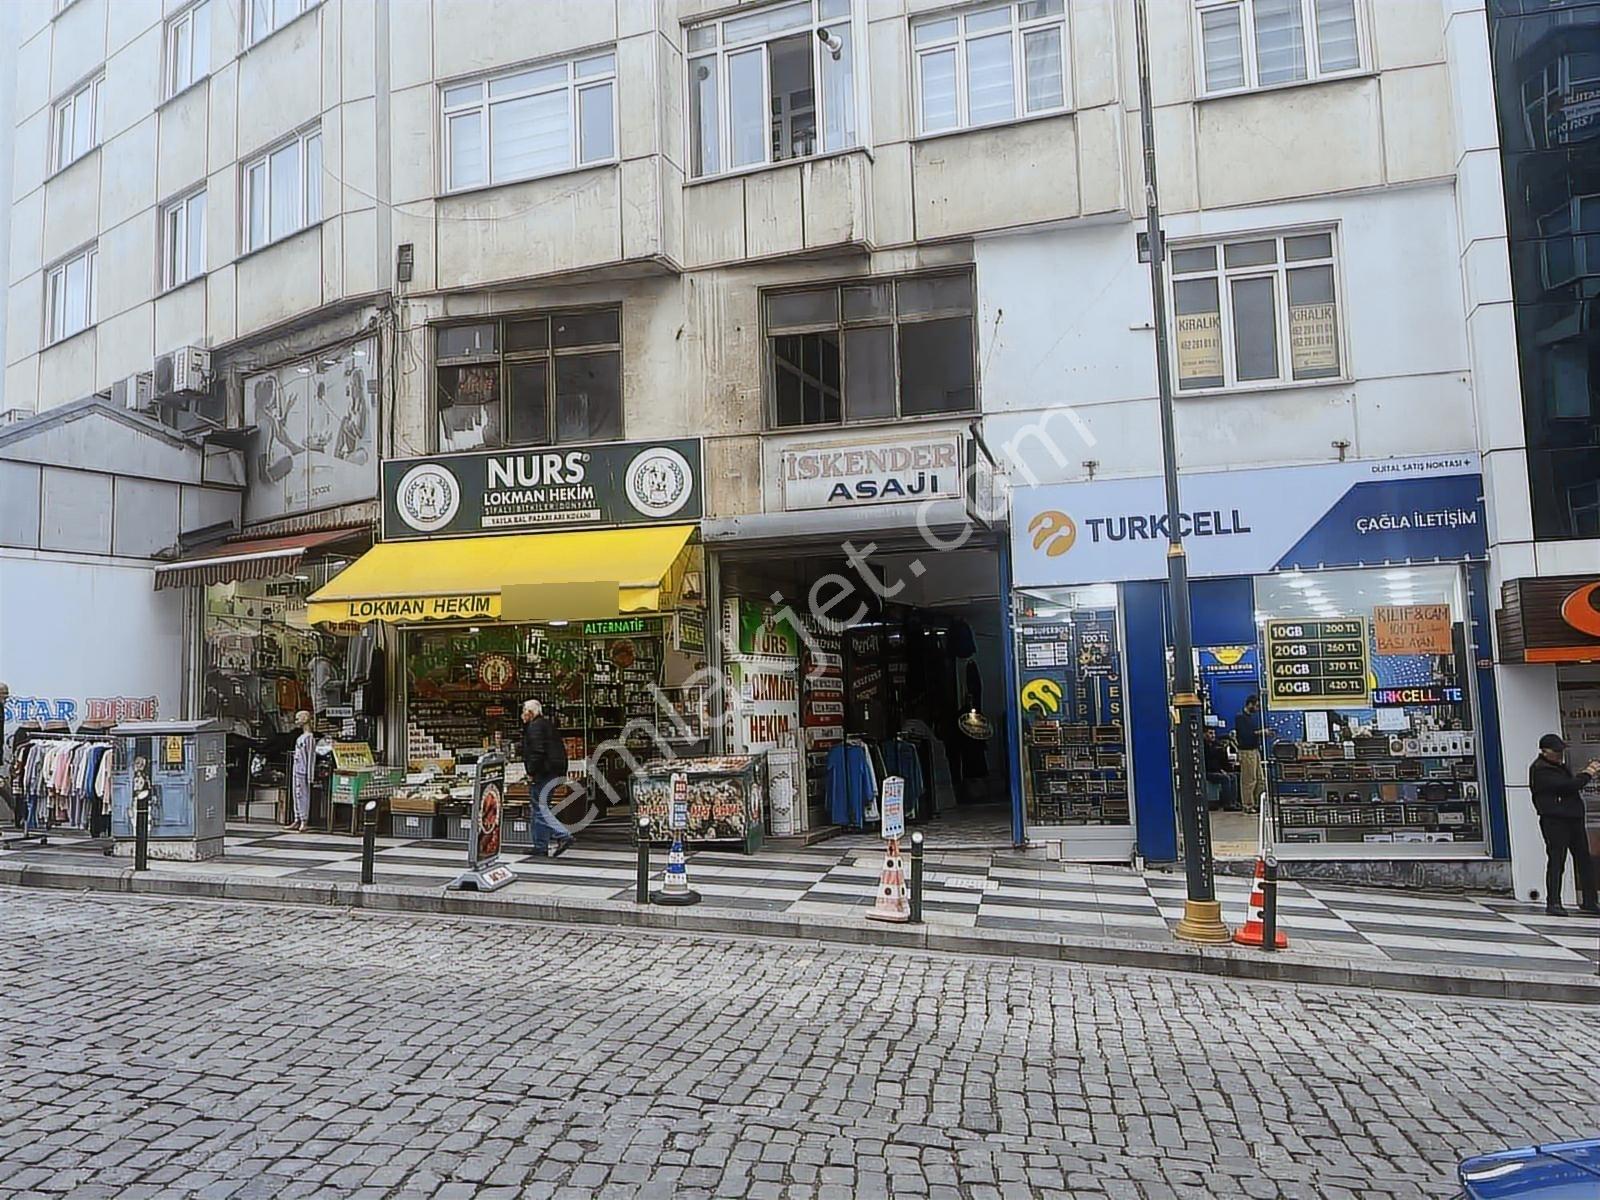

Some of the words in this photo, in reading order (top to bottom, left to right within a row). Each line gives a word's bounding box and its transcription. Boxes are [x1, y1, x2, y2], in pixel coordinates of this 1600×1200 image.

[487, 451, 585, 489] NURS
[484, 489, 545, 506] LOKMAN
[549, 484, 595, 501] HEKİM
[1085, 509, 1251, 543] TURKCELL
[1356, 513, 1411, 534] ÇAĞLA
[1414, 508, 1477, 529] İLETİŞİM
[349, 599, 425, 617] LOKMAN
[433, 595, 490, 613] HEKİM
[584, 617, 645, 634] ALTERNATİF
[1272, 625, 1303, 638] 10GB
[1325, 624, 1344, 633] 200
[1345, 623, 1358, 632] TL
[1275, 644, 1307, 657] 20GB
[1345, 643, 1358, 652] TL
[1276, 663, 1310, 675] 40GB
[1347, 661, 1359, 670] TL
[744, 671, 797, 701] OKMAN
[1278, 681, 1311, 693] 60GB
[1349, 680, 1361, 689] TL
